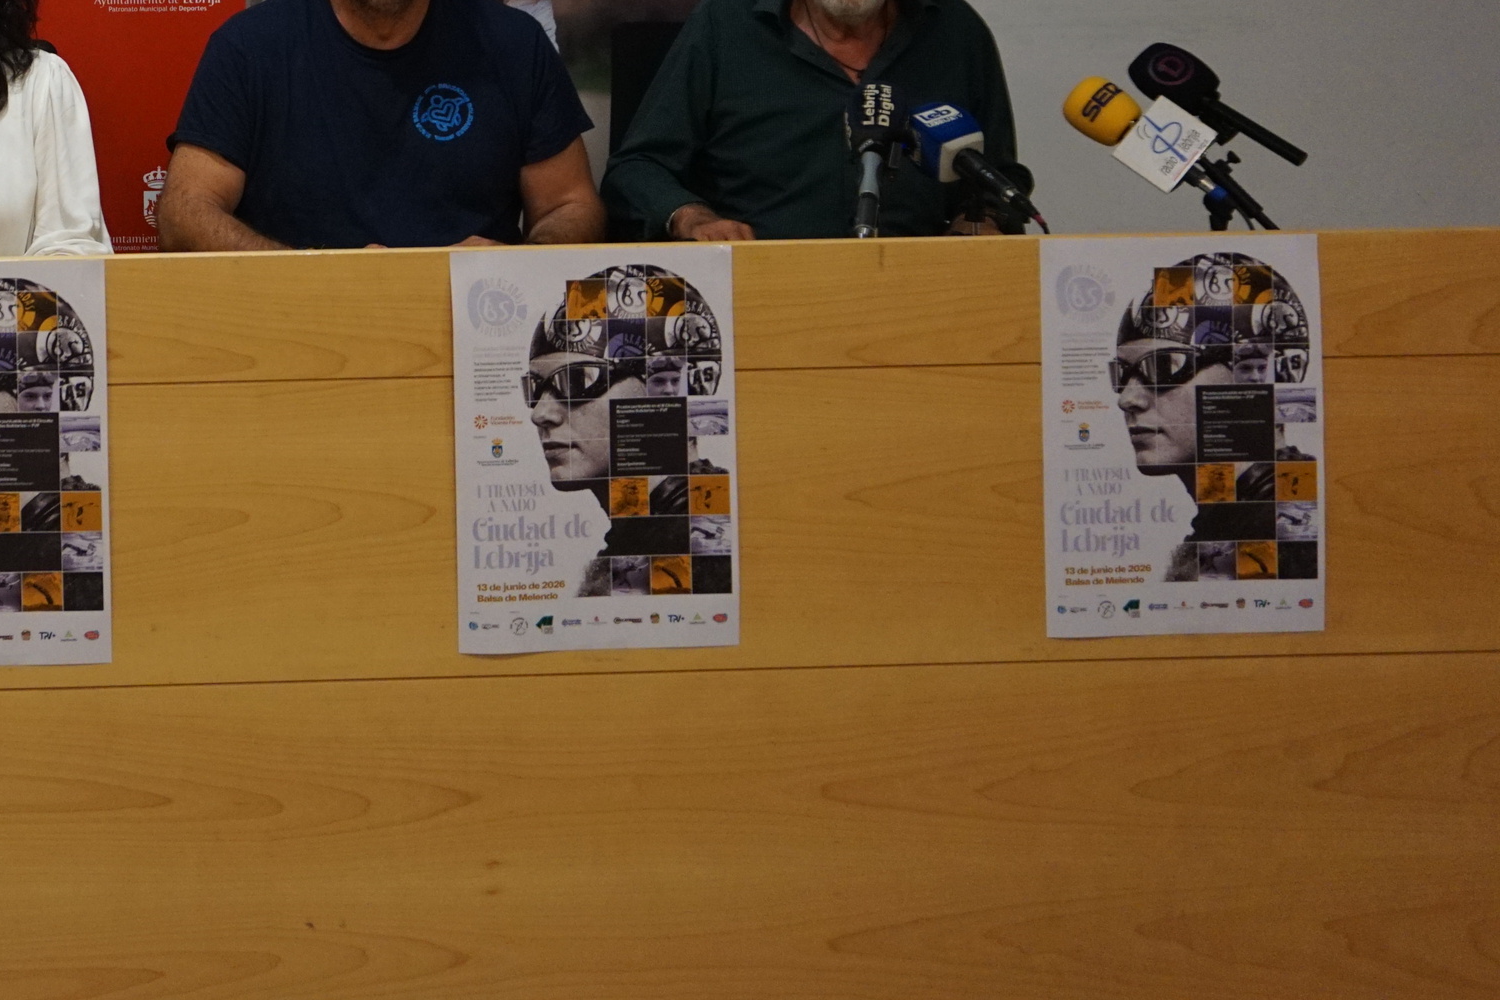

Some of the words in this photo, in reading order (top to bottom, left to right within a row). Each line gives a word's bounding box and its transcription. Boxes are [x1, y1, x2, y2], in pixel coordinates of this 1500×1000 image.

[862, 83, 880, 126] Lebrija
[878, 84, 895, 127] Digital
[1161, 155, 1179, 176] radio
[501, 499, 536, 512] NADO
[1060, 499, 1142, 525] Ciudad
[1150, 498, 1177, 523] de
[472, 514, 556, 542] Ciudad
[564, 513, 593, 539] de
[1062, 526, 1141, 558] Lebrija
[473, 542, 555, 576] Lebrija
[1065, 567, 1076, 575] 13
[1077, 566, 1089, 574] de
[1090, 565, 1113, 576] junio
[1115, 564, 1126, 573] de
[477, 584, 488, 592] 13
[489, 583, 501, 591] de
[502, 582, 527, 593] junio
[528, 581, 540, 590] de
[1065, 577, 1091, 586] Balsa
[1092, 577, 1104, 585] de
[477, 594, 503, 603] Balsa
[505, 594, 517, 602] de
